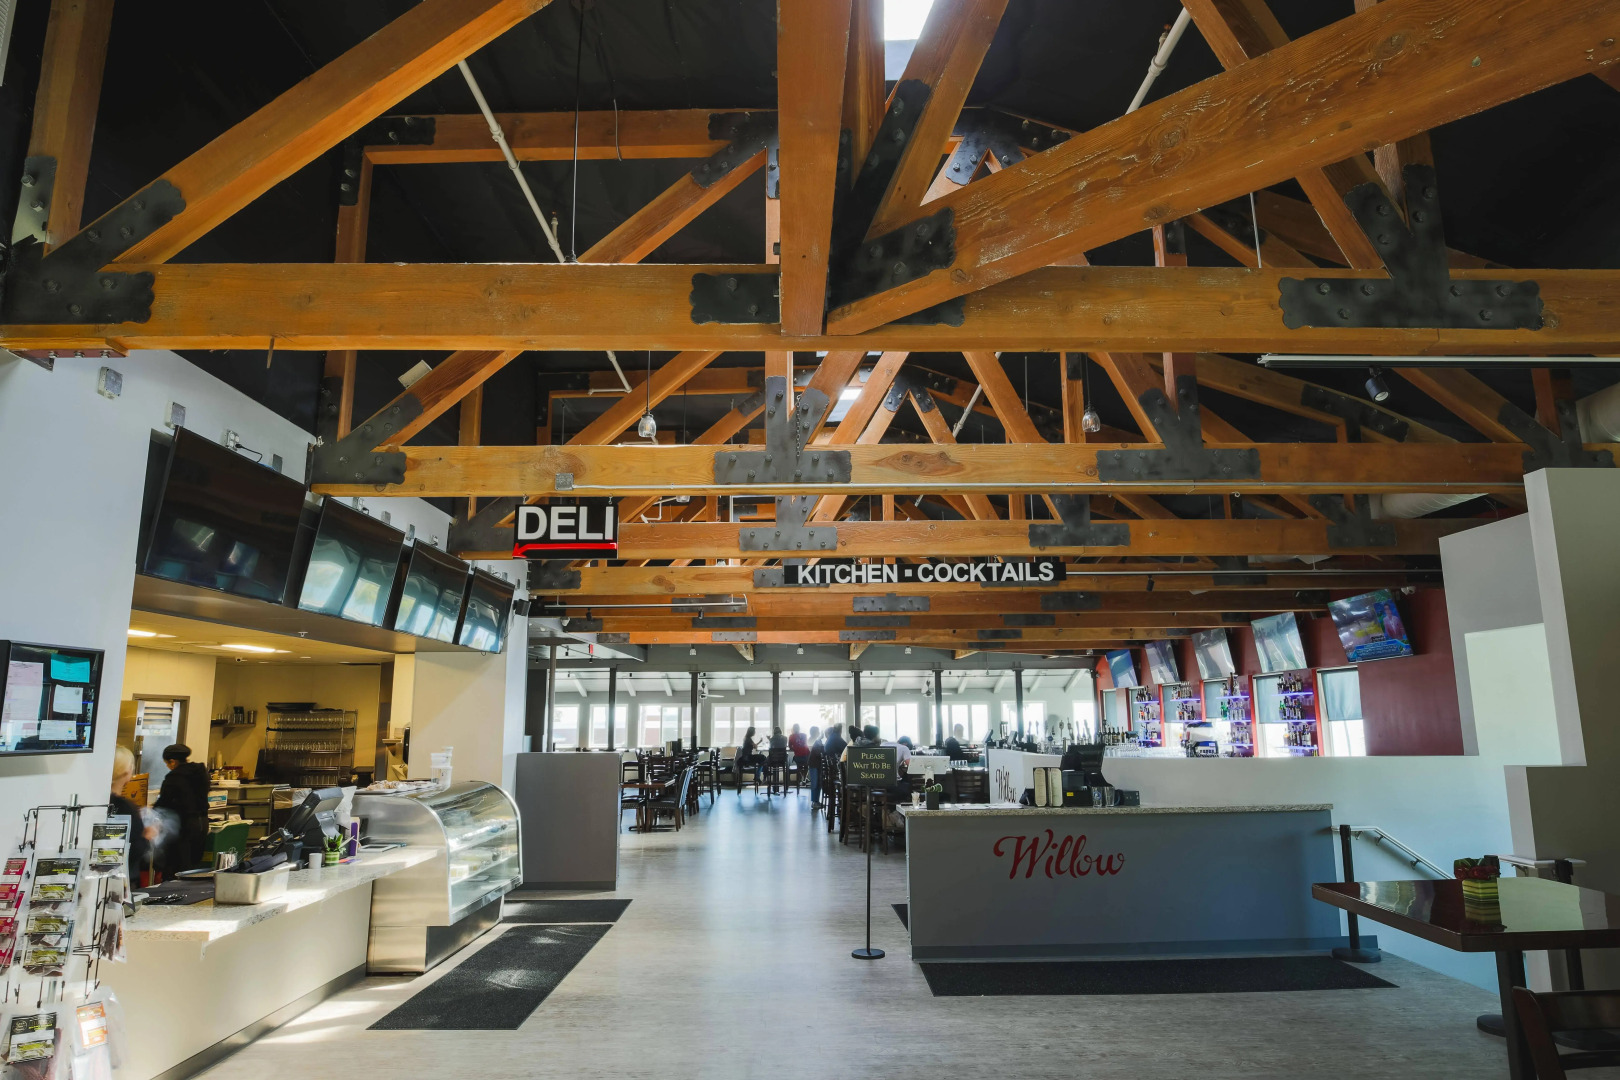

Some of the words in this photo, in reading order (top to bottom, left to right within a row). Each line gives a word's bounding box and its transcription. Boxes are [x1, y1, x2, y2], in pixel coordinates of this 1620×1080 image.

[517, 506, 614, 540] DELI
[797, 563, 898, 584] KITCHEN
[917, 562, 1054, 582] COCKTAILS
[993, 829, 1125, 880] Willow
